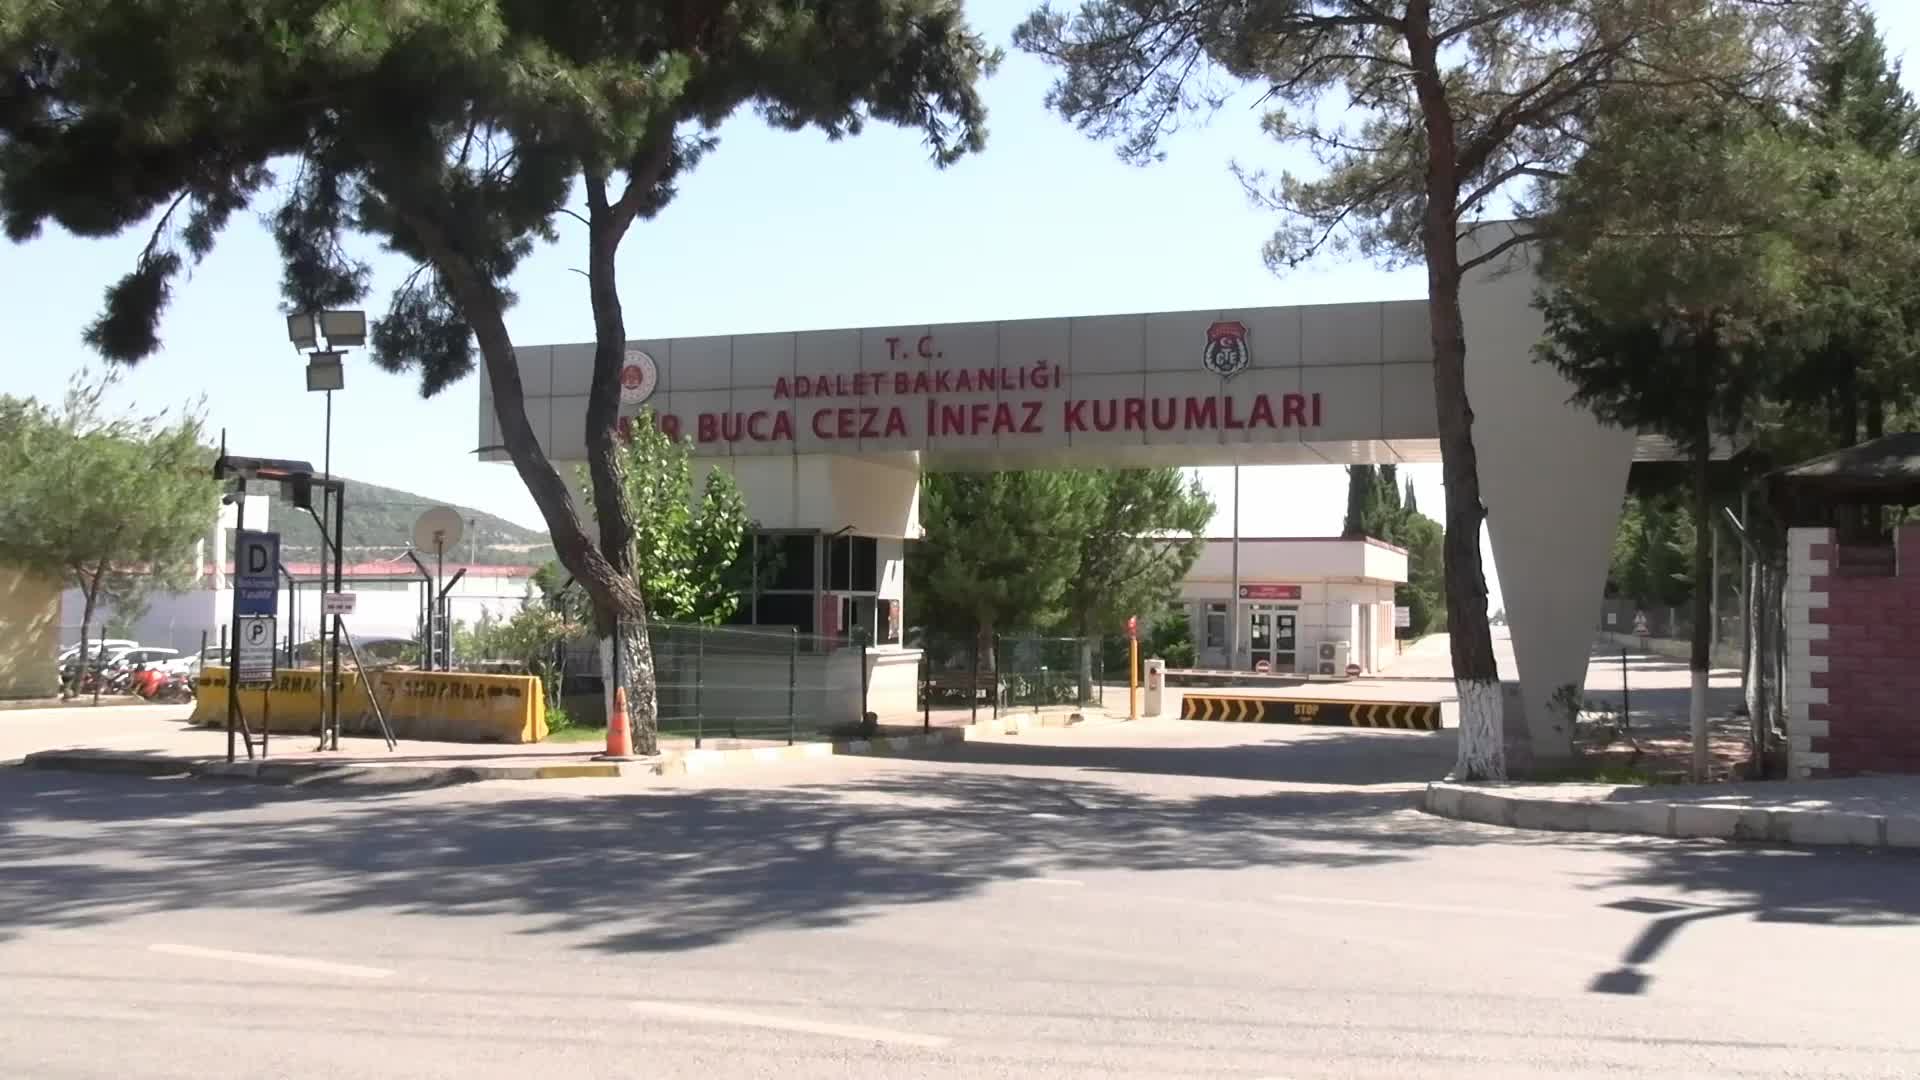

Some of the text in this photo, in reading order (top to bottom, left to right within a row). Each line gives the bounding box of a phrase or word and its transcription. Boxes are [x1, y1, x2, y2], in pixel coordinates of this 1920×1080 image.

[774, 359, 1060, 399] ADALET BAKANLIĞI
[698, 410, 793, 442] BUCA
[812, 406, 907, 439] CEZA
[927, 398, 1044, 437] İNFAZ
[1064, 392, 1322, 432] KURUMLARI
[249, 543, 267, 573] D
[252, 624, 263, 642] P
[1294, 703, 1320, 717] STOP
